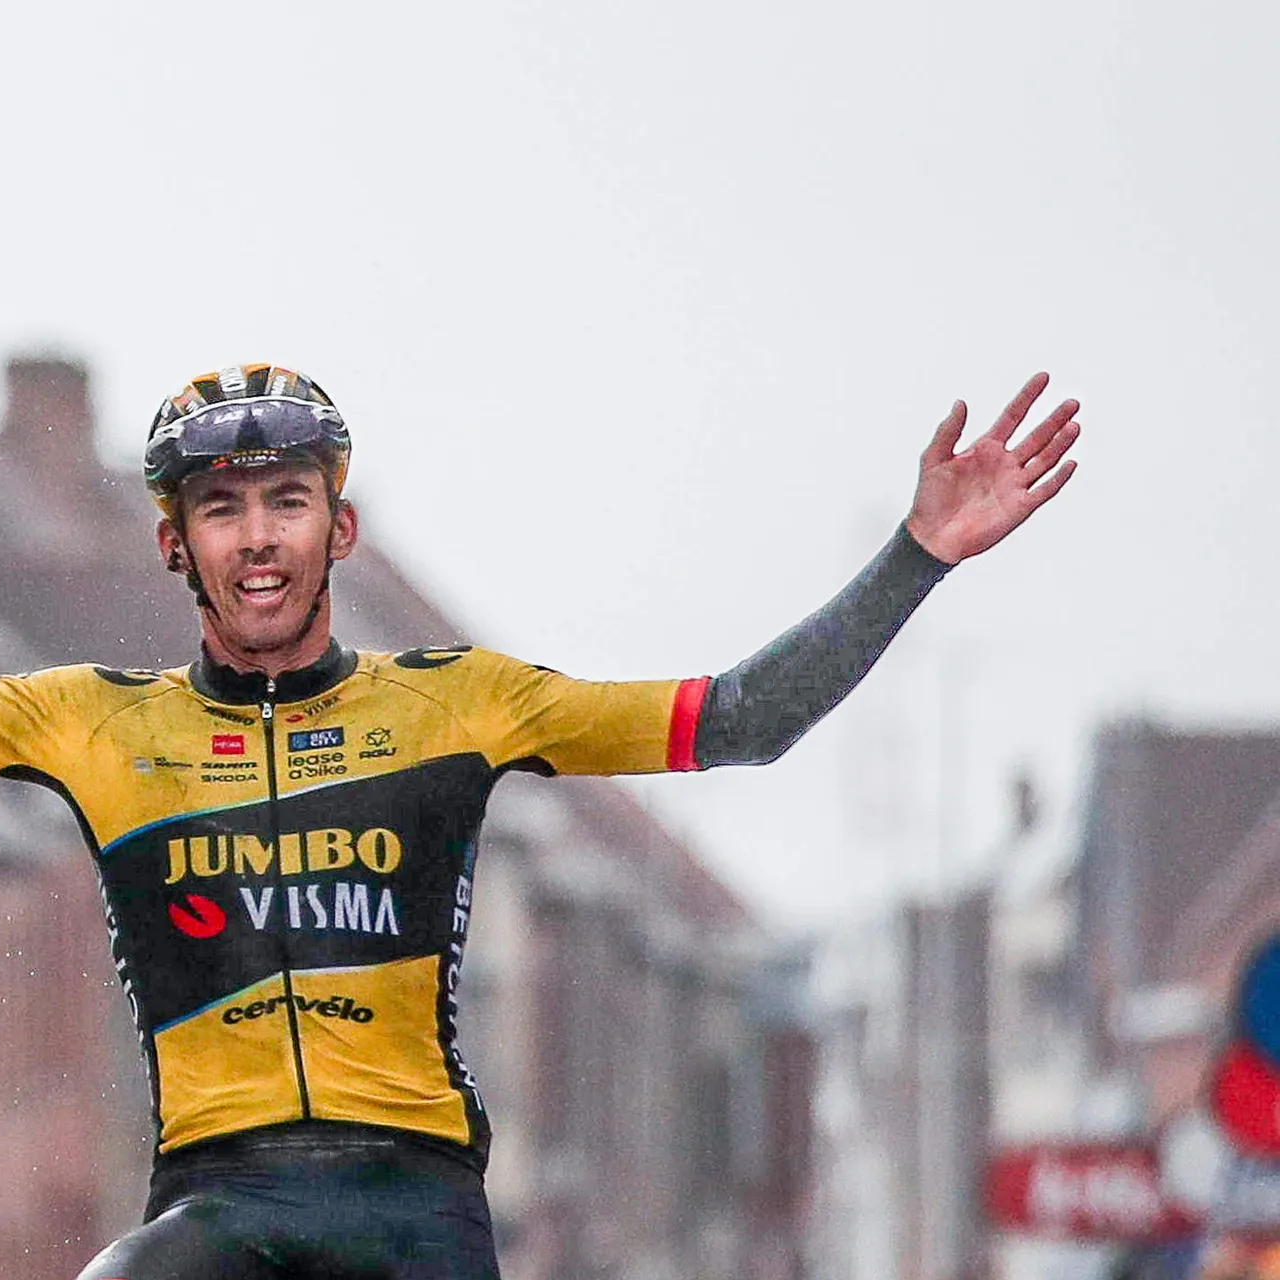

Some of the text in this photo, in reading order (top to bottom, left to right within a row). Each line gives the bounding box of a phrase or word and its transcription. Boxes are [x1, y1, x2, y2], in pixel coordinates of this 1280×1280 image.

[288, 752, 345, 768] lease
[359, 747, 397, 760] AGU
[163, 827, 403, 885] JUMBO
[239, 882, 400, 936] VISMA
[221, 994, 374, 1025] cervélo
